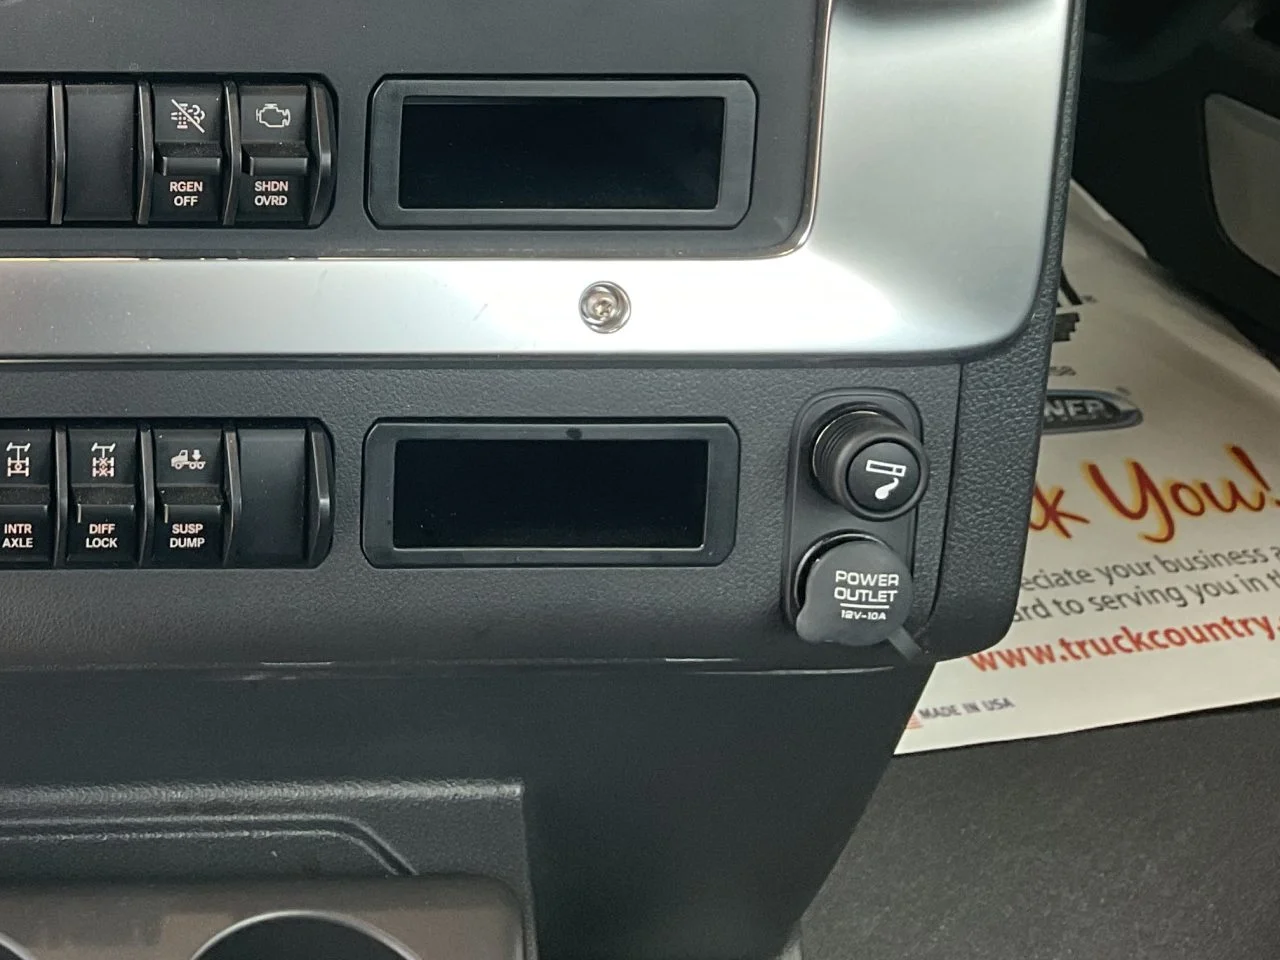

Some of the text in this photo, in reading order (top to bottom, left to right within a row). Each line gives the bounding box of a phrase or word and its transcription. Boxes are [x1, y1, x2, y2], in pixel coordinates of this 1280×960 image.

[169, 181, 203, 192] RGEN
[254, 180, 289, 192] SHDN
[173, 195, 199, 207] OFF
[254, 195, 288, 207] OVRD
[3, 523, 33, 535] INTR
[88, 523, 116, 535] DIFF
[171, 523, 204, 535] SUSP
[1, 537, 34, 549] AXLE
[85, 537, 118, 549] LOCK
[169, 537, 206, 549] DUMP
[1094, 560, 1156, 586] your
[1152, 544, 1269, 574] business
[835, 570, 900, 587] POWER
[834, 587, 899, 603] OUTLET
[1052, 596, 1085, 616] to
[1088, 584, 1188, 610] serving
[1184, 576, 1240, 605] you
[1233, 572, 1270, 593] in
[840, 609, 887, 621] 12V-10A
[918, 697, 1017, 719] MADE IN USA
